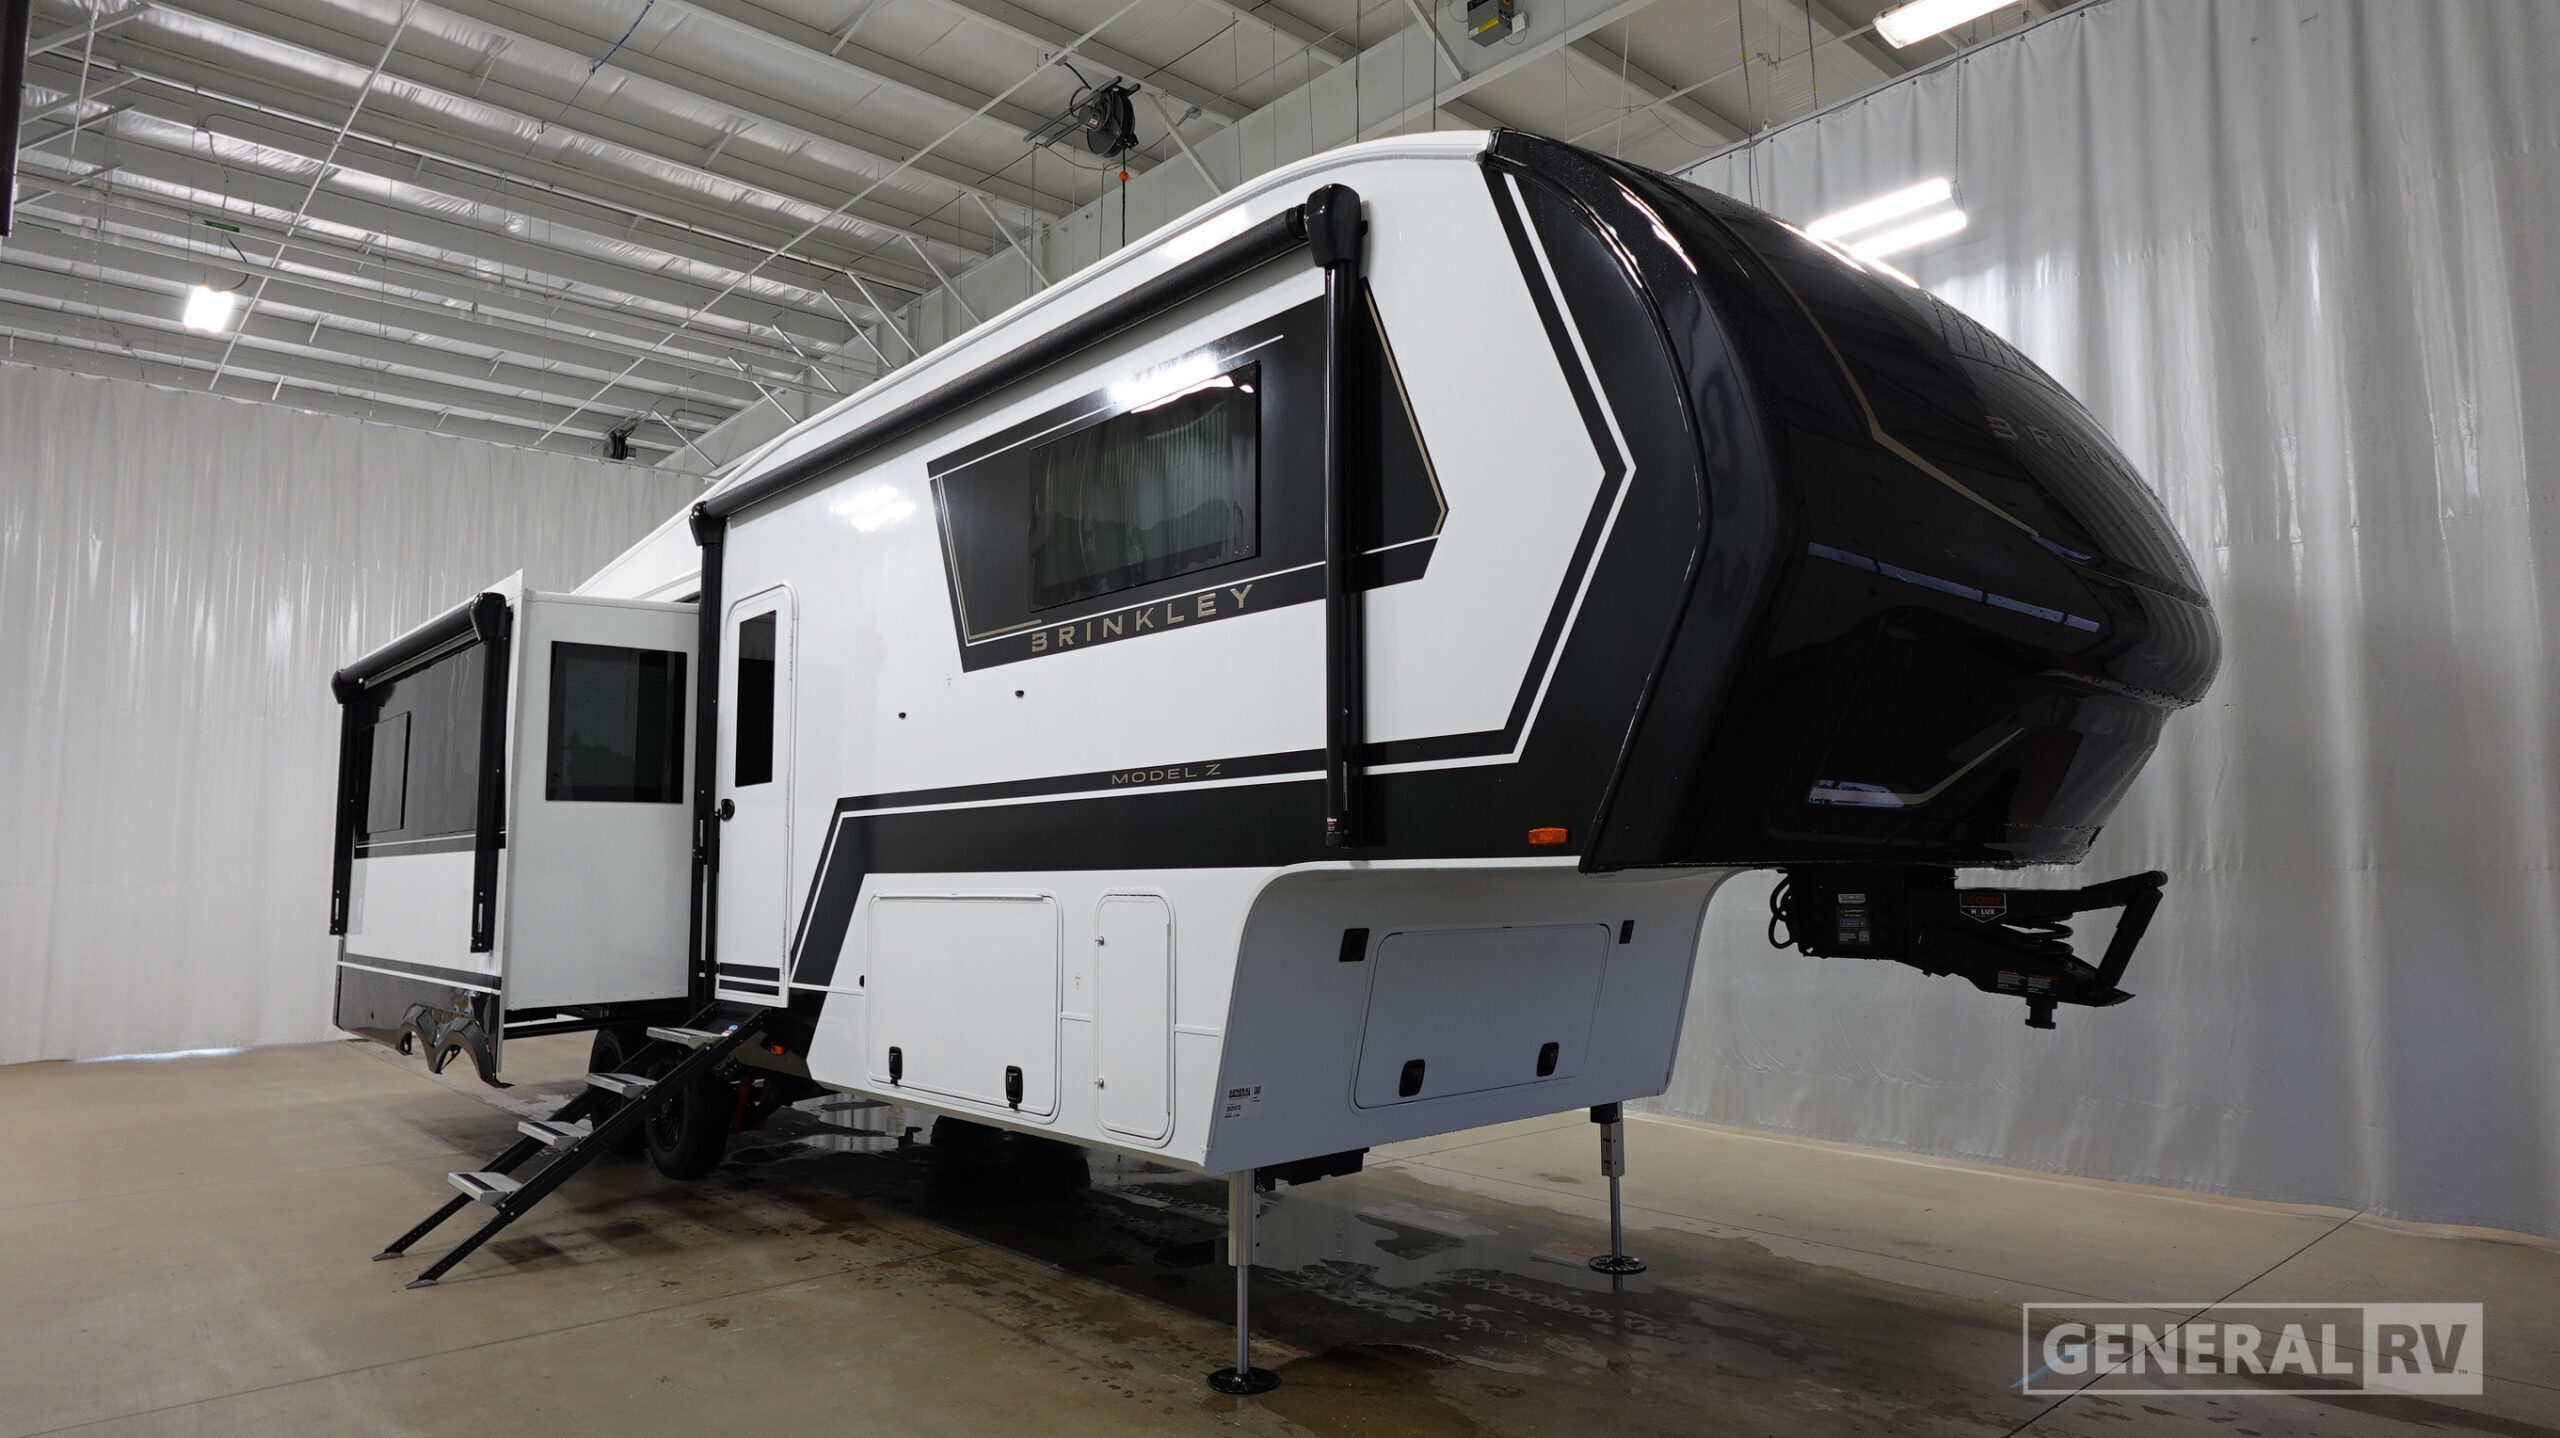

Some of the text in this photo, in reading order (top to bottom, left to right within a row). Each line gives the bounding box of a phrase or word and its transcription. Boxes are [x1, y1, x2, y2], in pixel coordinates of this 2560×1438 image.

[1031, 584, 1254, 653] BRINKLEY
[1111, 763, 1222, 785] MODEL Z
